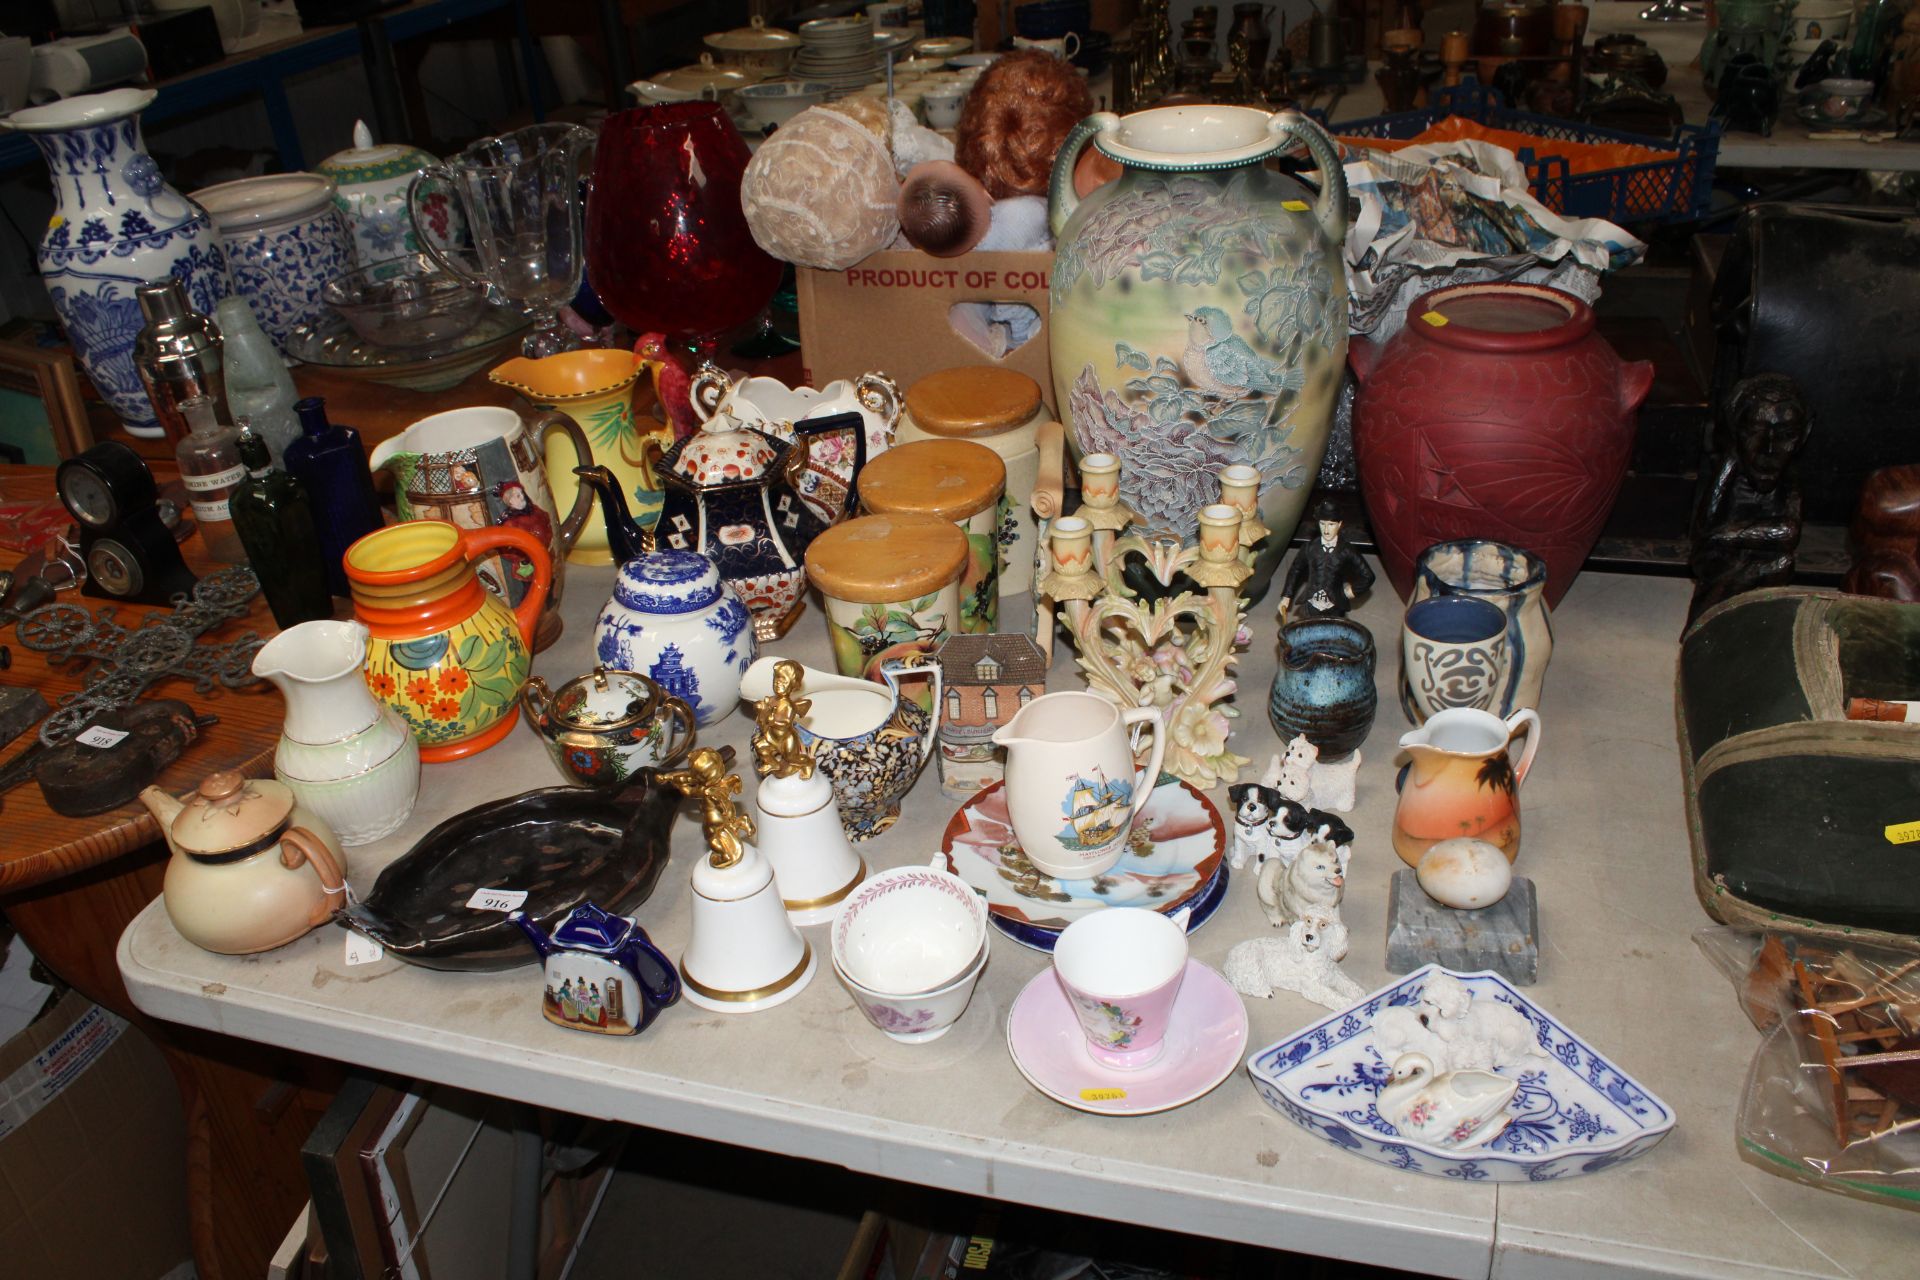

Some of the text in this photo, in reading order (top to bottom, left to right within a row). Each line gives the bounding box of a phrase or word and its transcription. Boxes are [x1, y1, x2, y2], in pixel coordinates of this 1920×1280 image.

[847, 269, 1050, 290] PRODUCT OF COL
[92, 736, 112, 746] 918
[484, 898, 509, 909] 916
[47, 1006, 101, 1058] HUMPHREY
